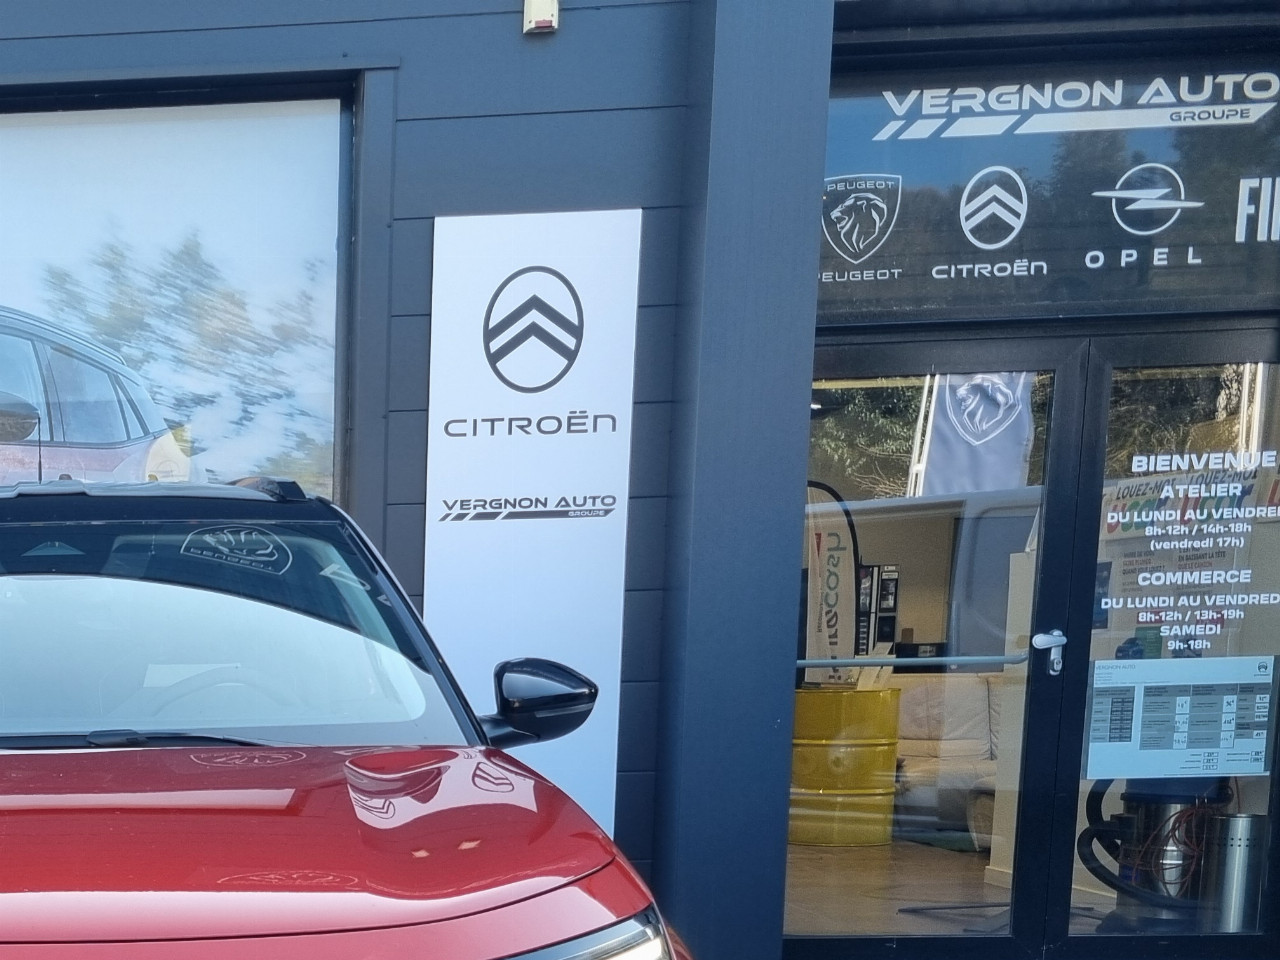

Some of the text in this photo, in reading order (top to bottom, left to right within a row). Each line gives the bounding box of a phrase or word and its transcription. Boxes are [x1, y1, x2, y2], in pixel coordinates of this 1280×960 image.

[881, 72, 1280, 116] VERGNON AUTO
[1170, 108, 1251, 122] GROUPE
[827, 181, 894, 191] PEUGEOT
[1084, 247, 1202, 269] OPEL
[818, 269, 902, 282] EUGEOT
[1131, 451, 1277, 472] BIENVENUE
[1160, 483, 1242, 498] ATELIER
[441, 495, 616, 511] VERGNON AUTO
[1107, 512, 1129, 523] DU
[1134, 510, 1181, 522] LUNDI
[1184, 509, 1208, 520] AU
[1145, 525, 1189, 536] 8h-12h
[1201, 523, 1251, 535] 14h-18h
[1150, 538, 1213, 551] (vendredi
[1217, 536, 1245, 548] 17h)
[1138, 570, 1251, 586] COMMERCE
[1101, 598, 1123, 609] DU
[1127, 596, 1174, 608] LUNDI
[1177, 595, 1201, 607] AU
[1138, 611, 1182, 622] 8h-12h
[1194, 609, 1244, 620] 13h-19h
[1160, 624, 1220, 636] SAMEDI
[1167, 640, 1211, 650] 9h-18h
